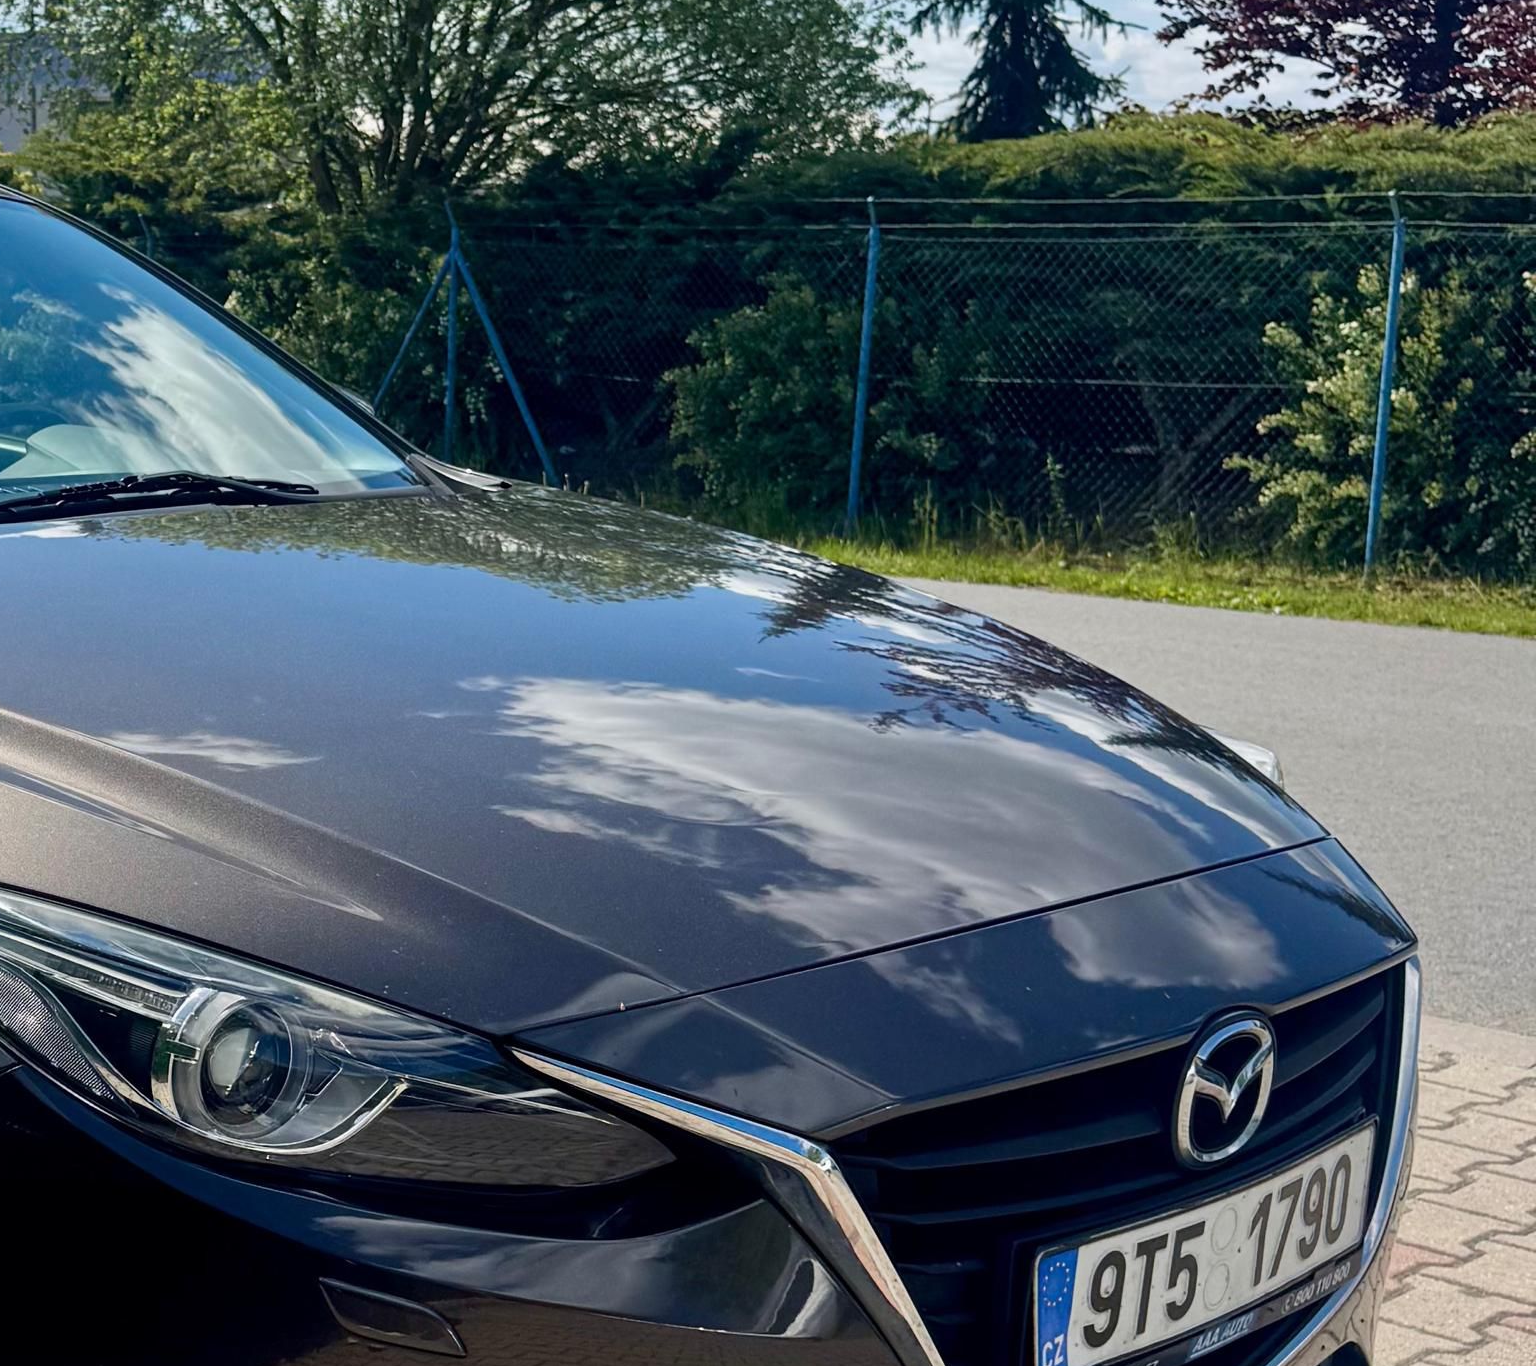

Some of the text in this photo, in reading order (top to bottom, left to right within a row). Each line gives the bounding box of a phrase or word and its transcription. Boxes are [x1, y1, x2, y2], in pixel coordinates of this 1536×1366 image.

[1083, 1154, 1352, 1348] 9T5 1790
[1293, 1283, 1315, 1307] 800
[1192, 1313, 1254, 1353] AAA AUTO
